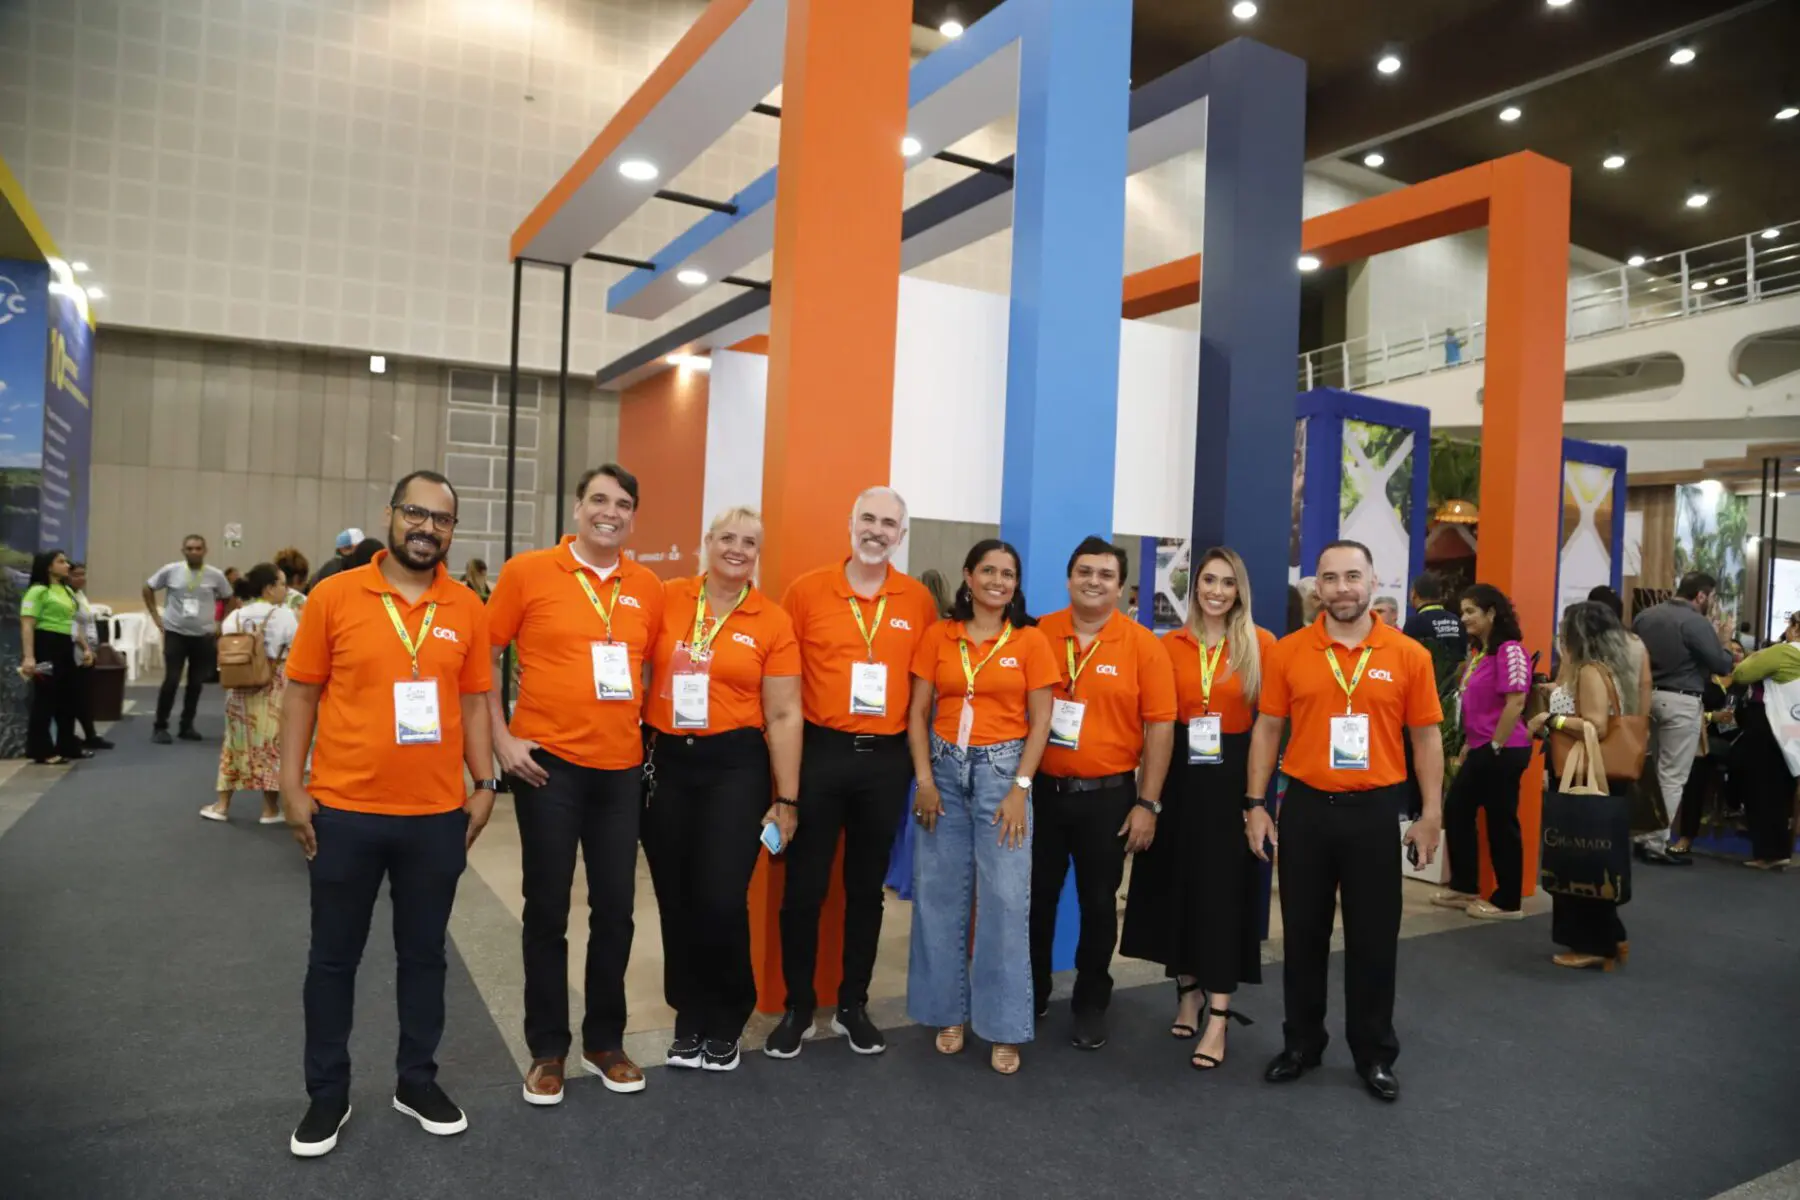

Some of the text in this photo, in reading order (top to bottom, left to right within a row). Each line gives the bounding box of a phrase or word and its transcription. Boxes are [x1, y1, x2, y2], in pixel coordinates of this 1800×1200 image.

[618, 595, 641, 609] GOL
[889, 617, 911, 630] GOL
[433, 626, 459, 642] GOL
[732, 632, 756, 648] GOL
[999, 657, 1018, 668] GO
[1096, 664, 1118, 676] GOL
[1368, 668, 1393, 682] GOL
[1544, 827, 1613, 851] GRMADO
